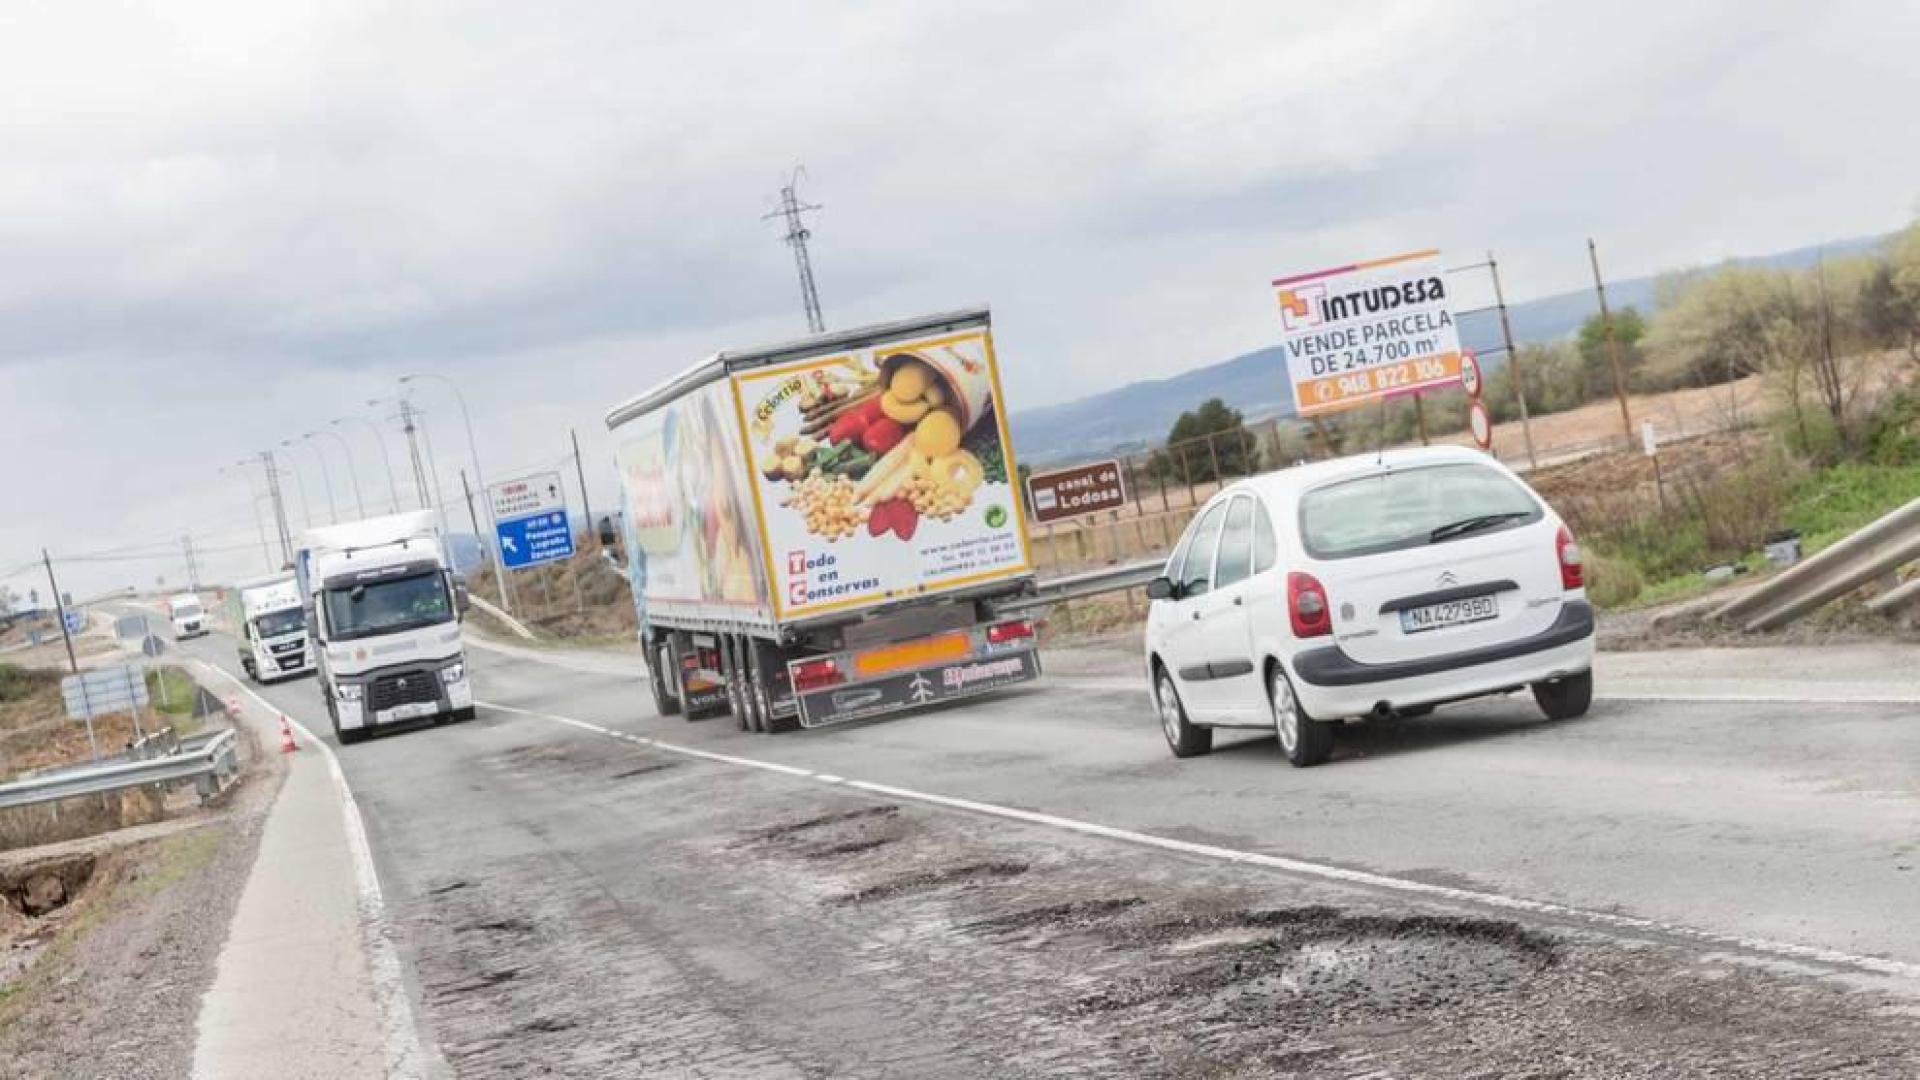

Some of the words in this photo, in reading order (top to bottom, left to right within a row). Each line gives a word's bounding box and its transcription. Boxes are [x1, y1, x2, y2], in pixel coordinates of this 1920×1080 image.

[1287, 328, 1358, 358] VENDE
[1362, 309, 1453, 342] PARCELA
[1310, 354, 1339, 376] DE
[1343, 340, 1411, 369] 24.700
[1058, 473, 1094, 491] canal
[1099, 470, 1116, 482] de
[1060, 488, 1119, 508] Lodosa
[788, 550, 836, 575] Todo
[818, 571, 839, 582] en
[790, 577, 880, 606] Conservas
